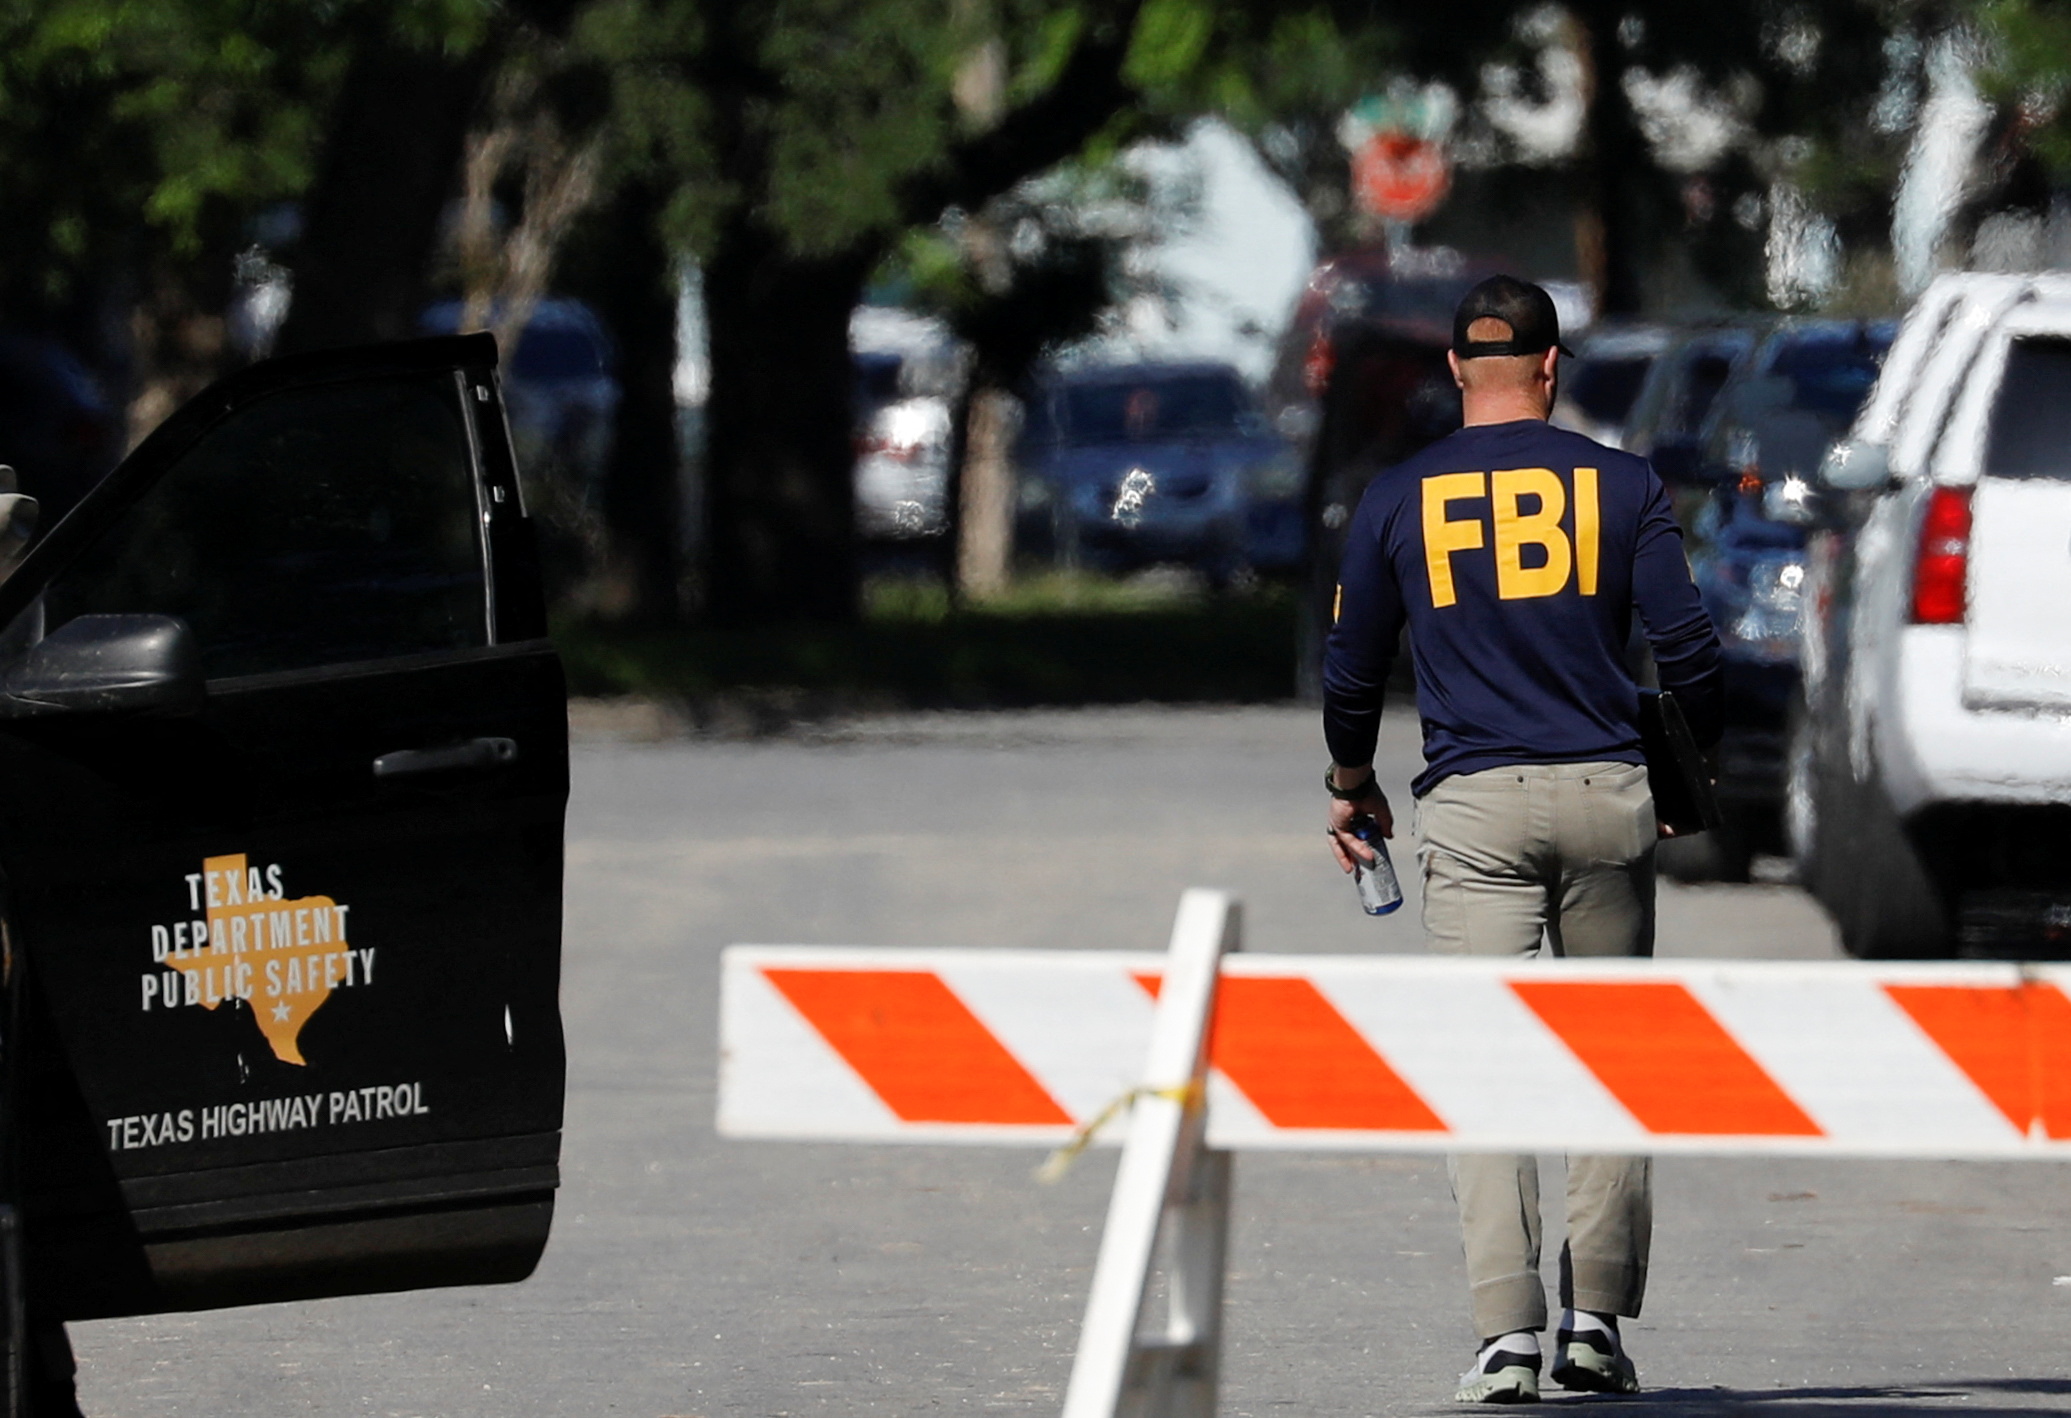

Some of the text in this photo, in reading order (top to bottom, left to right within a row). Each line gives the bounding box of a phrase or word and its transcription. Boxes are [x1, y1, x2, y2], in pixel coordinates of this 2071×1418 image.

[1422, 467, 1599, 608] FBI
[185, 864, 283, 911] TEXAS
[152, 905, 349, 963] DEPARTMENT
[141, 948, 376, 1011] PUBLIC SAFETY
[107, 1082, 428, 1150] TEXAS HIGHWAY PATROL
